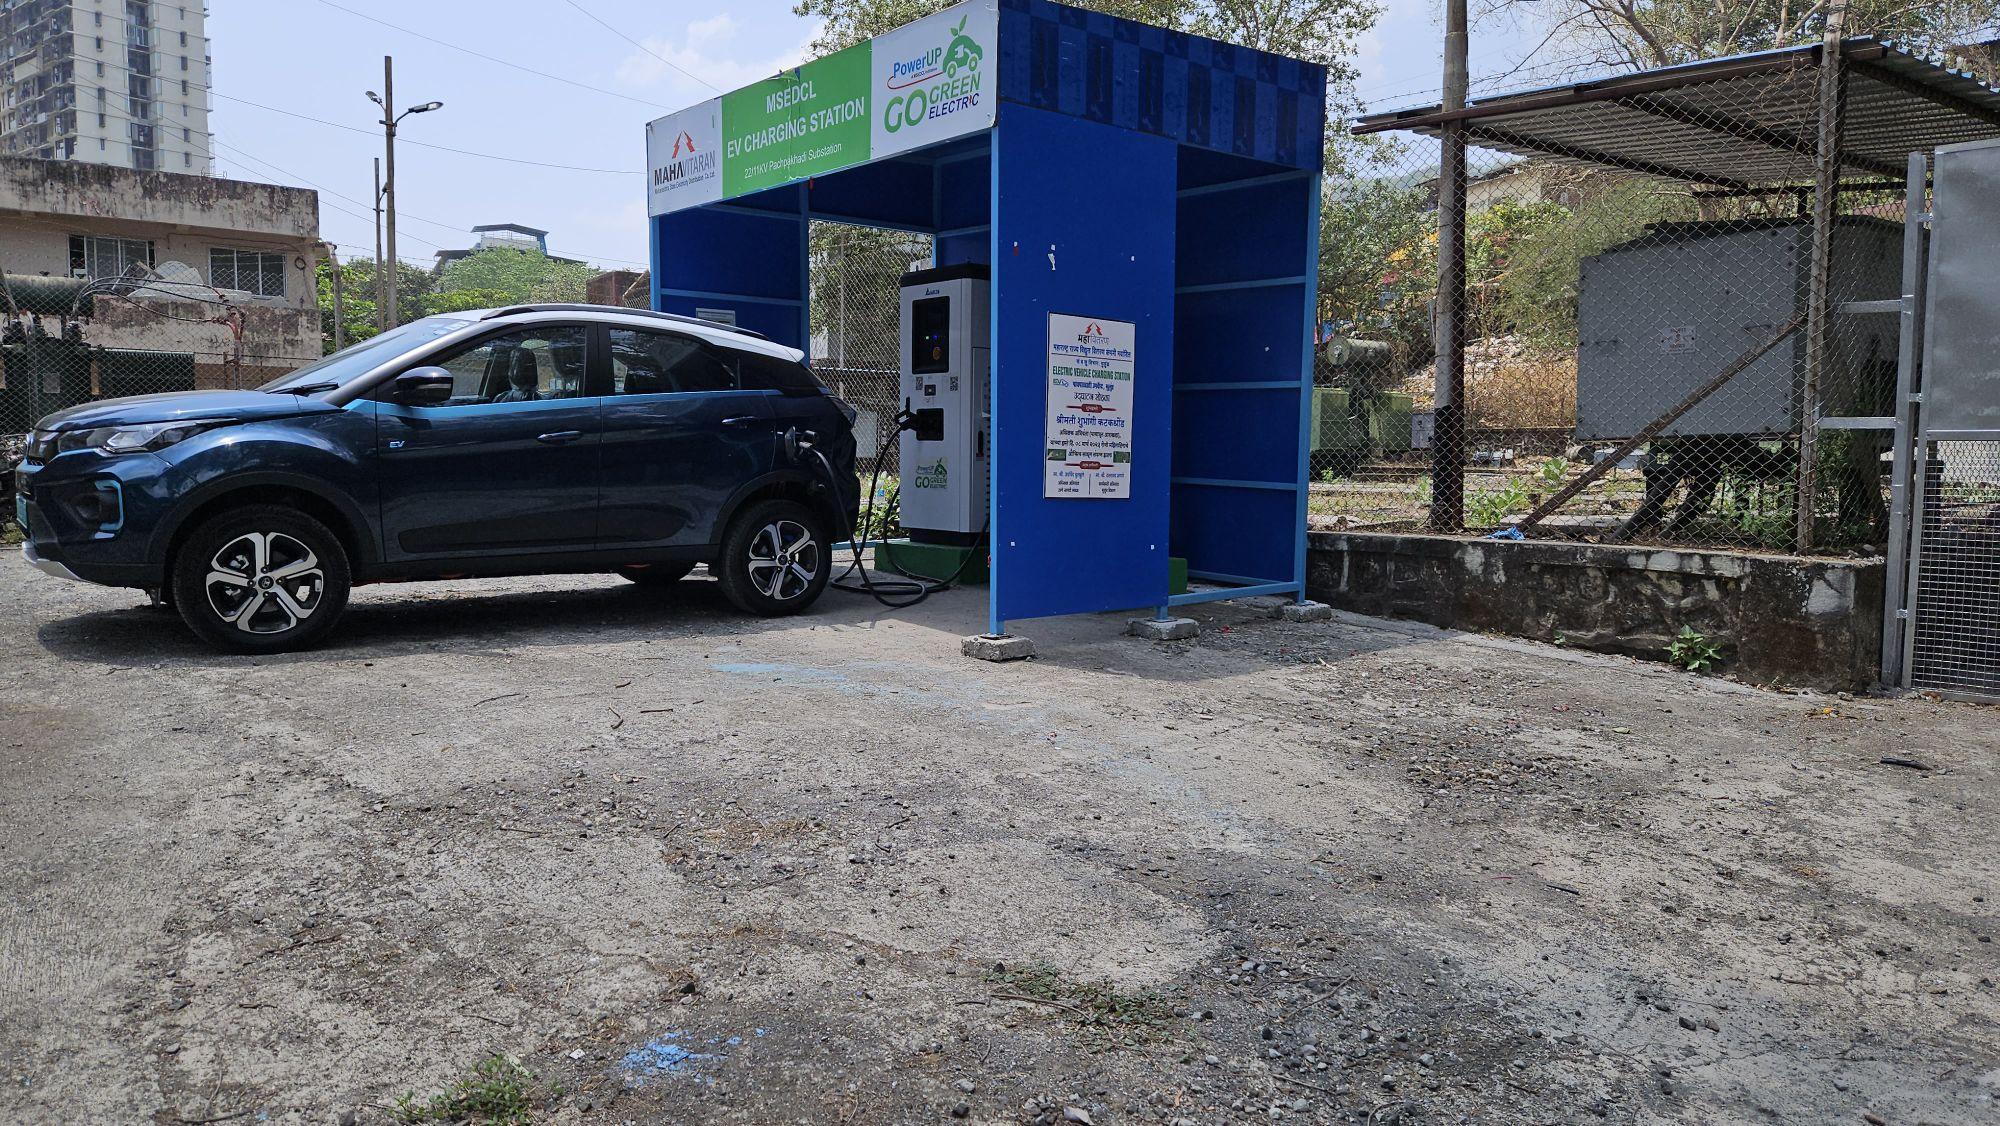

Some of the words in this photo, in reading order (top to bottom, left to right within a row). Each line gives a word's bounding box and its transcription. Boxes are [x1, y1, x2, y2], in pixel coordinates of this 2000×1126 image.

[893, 47, 942, 78] PowerUP
[766, 80, 816, 114] MSEDCL
[929, 71, 980, 104] GREEN
[884, 89, 927, 133] GO
[929, 93, 979, 120] ELECTRIC
[727, 138, 742, 158] EV
[744, 117, 806, 152] CHARGING
[810, 96, 864, 132] STATION
[654, 150, 715, 186] MAHAVITARAN
[769, 153, 807, 170] Pachpakhadi
[808, 143, 842, 160] Substation
[1053, 366, 1073, 376] ELECTRIC
[1074, 368, 1091, 378] VEHICLE
[1092, 369, 1113, 379] CHARGING
[1114, 371, 1130, 381] STATION
[1056, 414, 1076, 424] श्रीमती
[915, 476, 930, 488] GO
